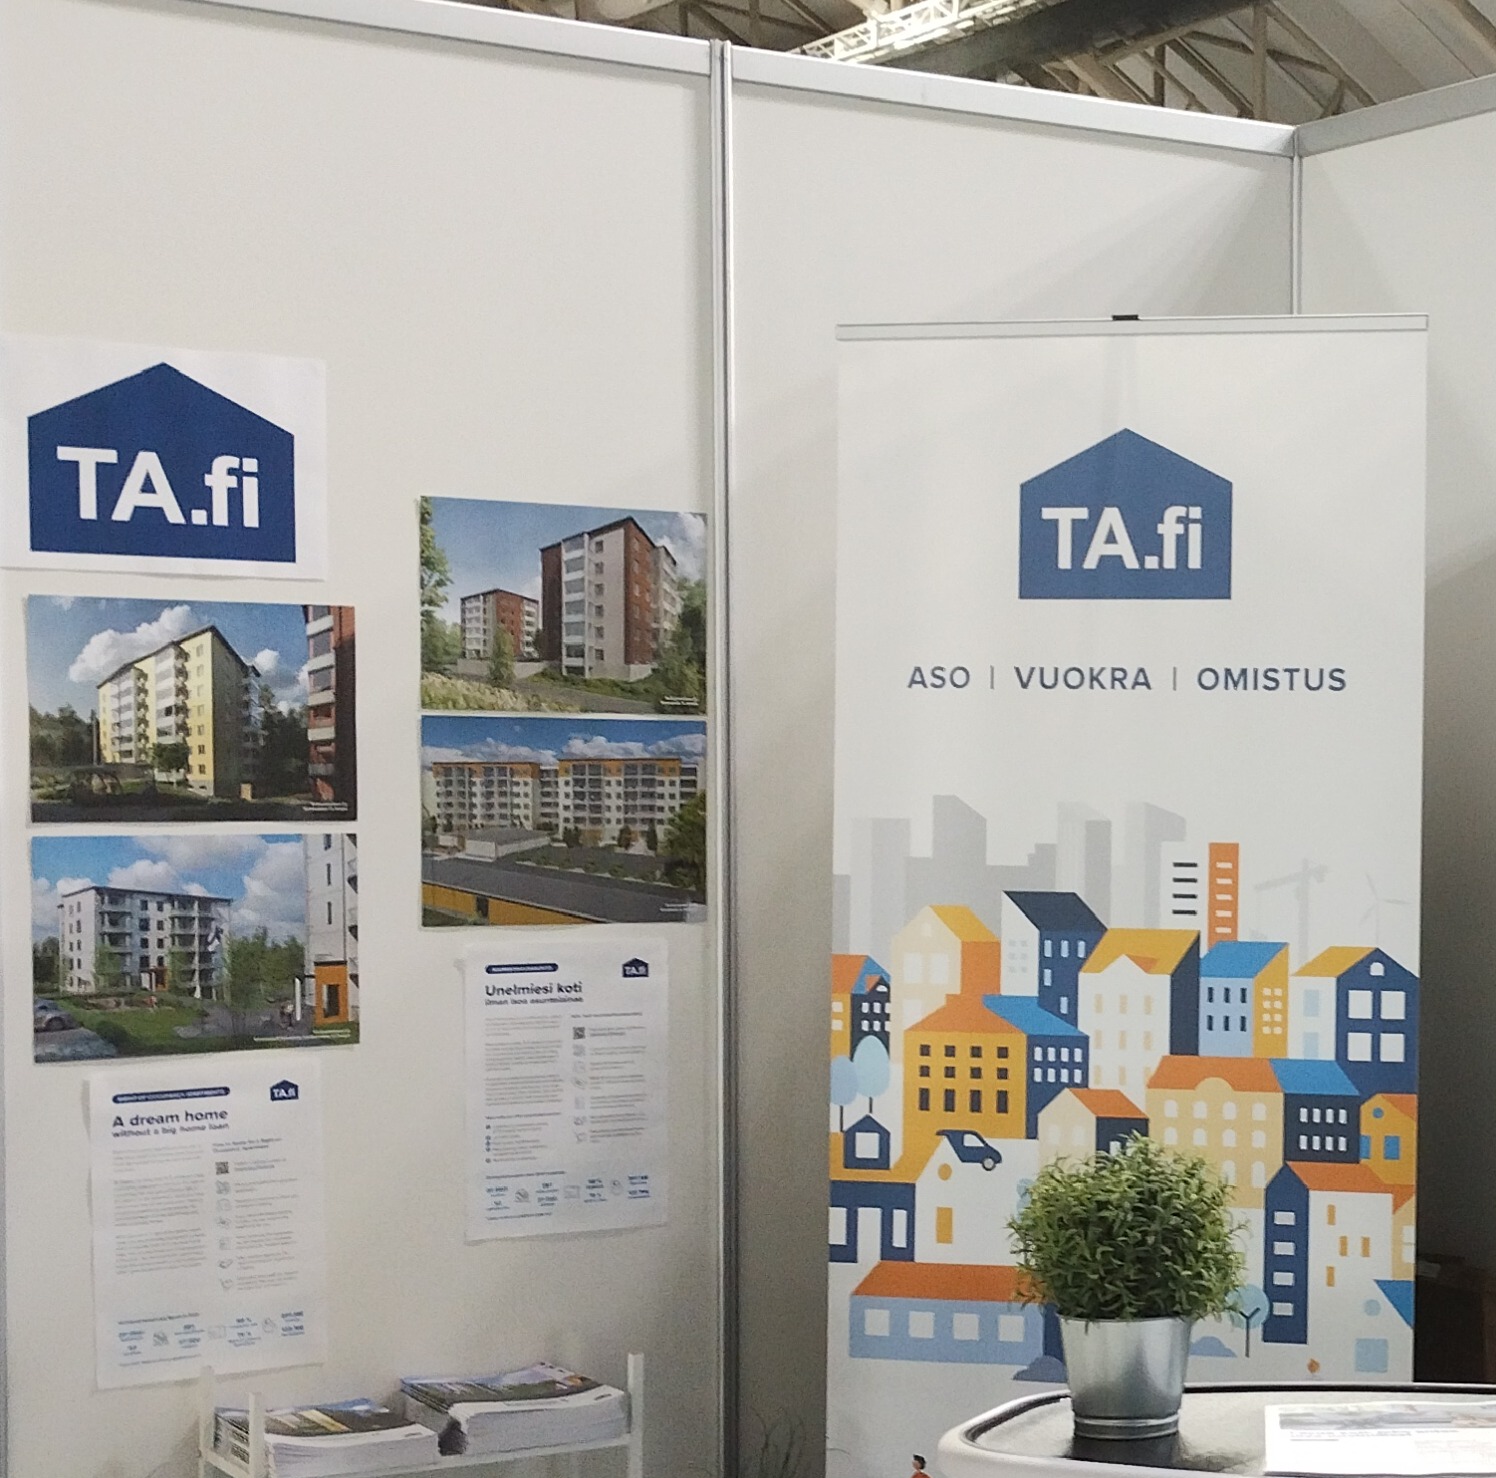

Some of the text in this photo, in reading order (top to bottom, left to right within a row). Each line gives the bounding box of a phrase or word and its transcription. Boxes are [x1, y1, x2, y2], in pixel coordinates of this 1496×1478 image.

[57, 445, 260, 528] TA.fi
[1041, 506, 1203, 570] TA.fi
[907, 666, 1347, 692] ASO VUOKRA OMISTUS
[485, 980, 583, 997] Unelmiesi koti
[112, 1109, 228, 1127] A dream home
